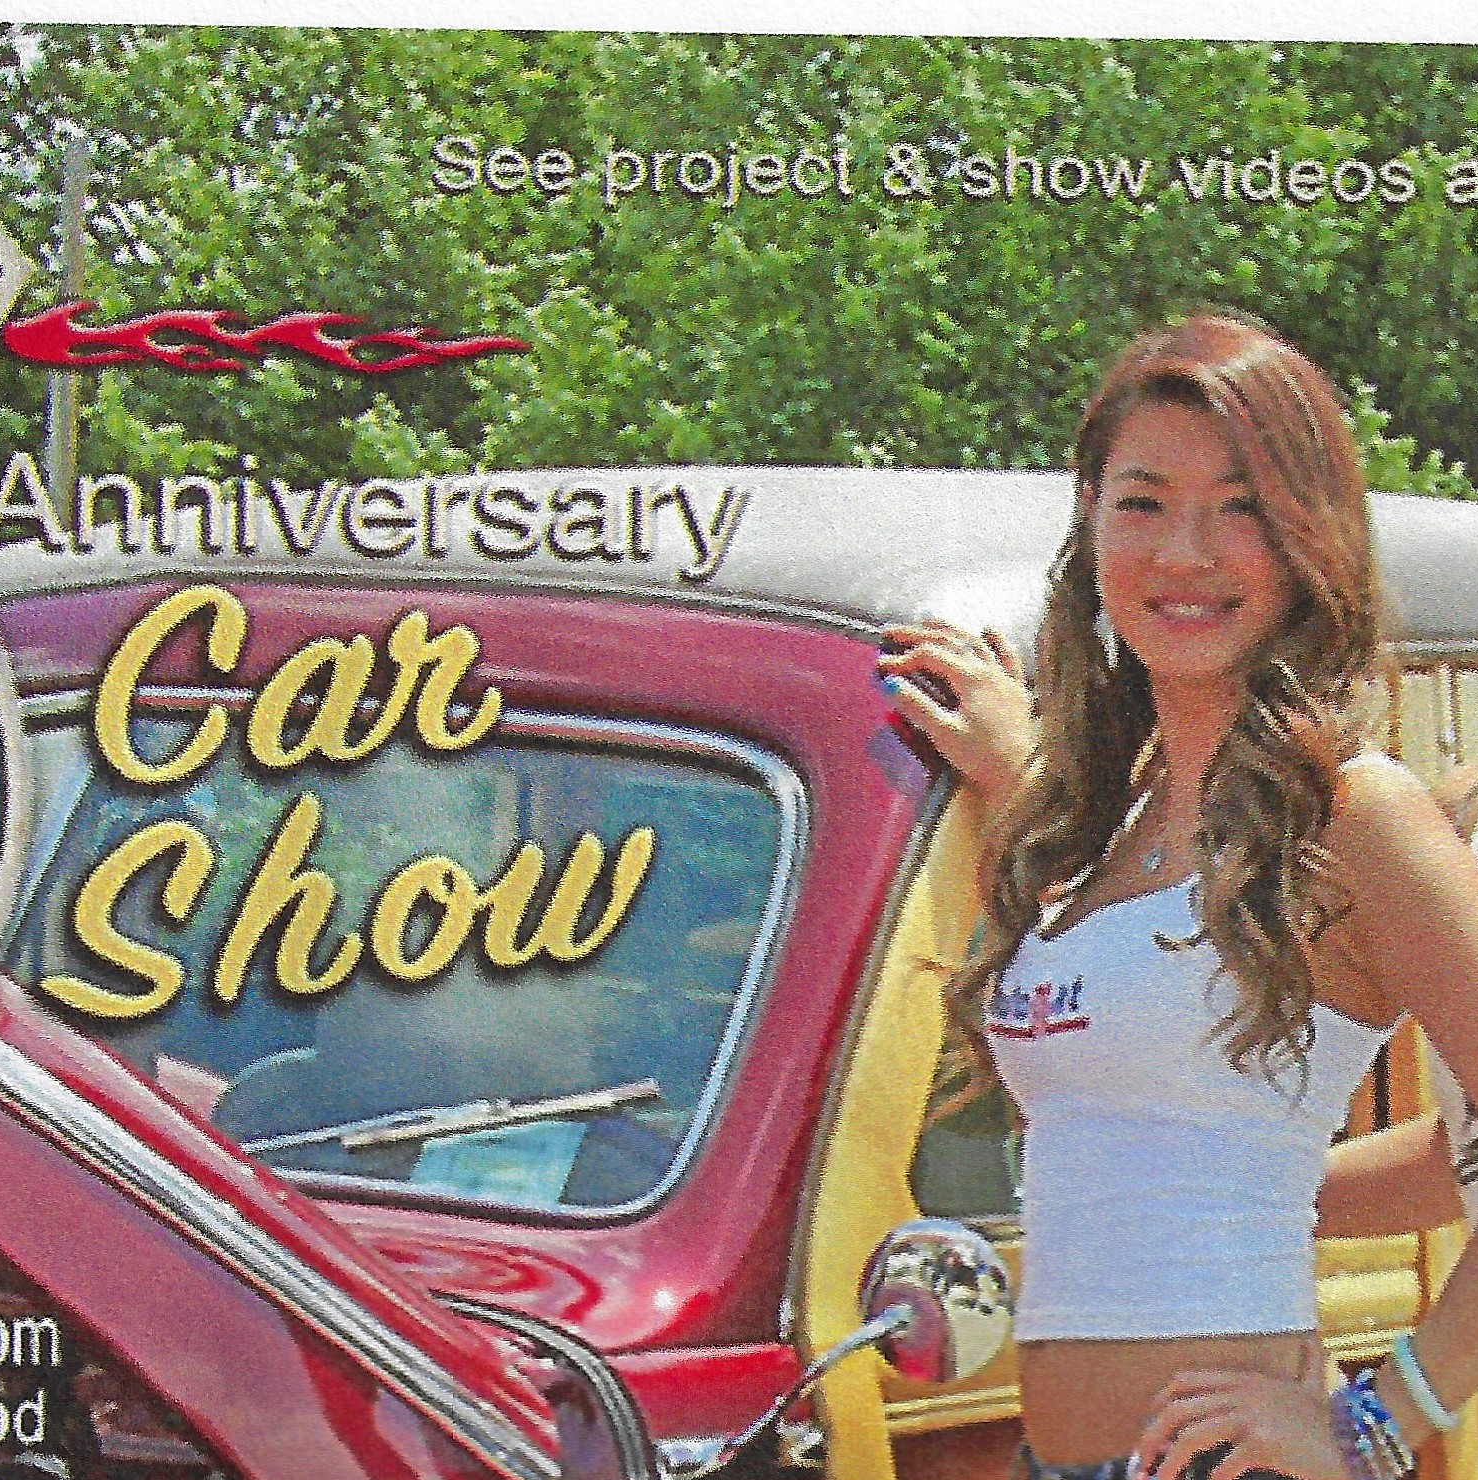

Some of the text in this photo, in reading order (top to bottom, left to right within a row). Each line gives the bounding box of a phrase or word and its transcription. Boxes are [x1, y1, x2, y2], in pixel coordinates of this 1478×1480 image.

[432, 136, 574, 194] See
[605, 142, 855, 208] project
[884, 145, 920, 197] &
[962, 147, 1150, 200] show
[1179, 149, 1418, 204] videos
[93, 586, 502, 784] Car
[41, 793, 656, 1017] Show
